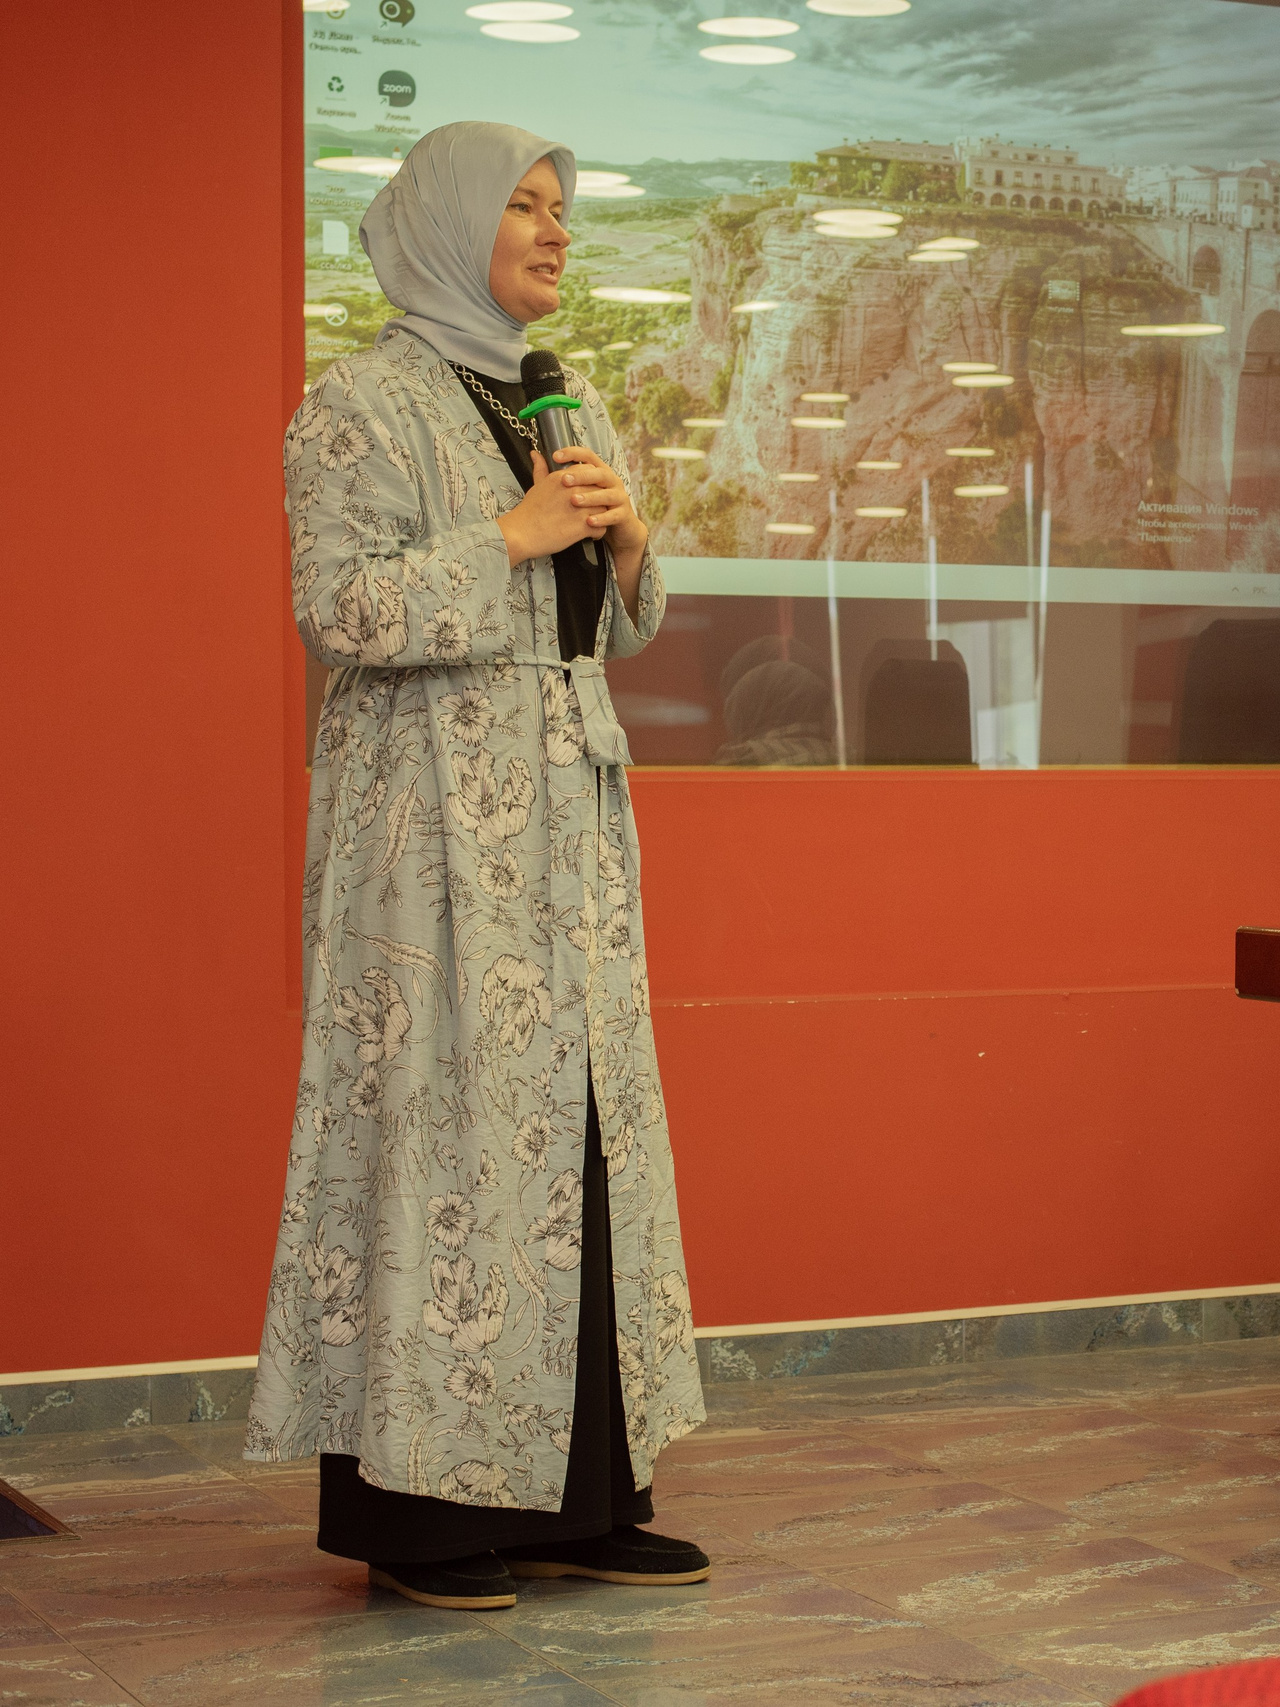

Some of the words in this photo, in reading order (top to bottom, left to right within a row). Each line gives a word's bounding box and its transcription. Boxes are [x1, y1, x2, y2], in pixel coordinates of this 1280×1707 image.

[383, 84, 411, 93] zoom
[1137, 500, 1202, 515] Активация
[1205, 502, 1259, 516] Windows
[1137, 518, 1166, 528] Чтобы
